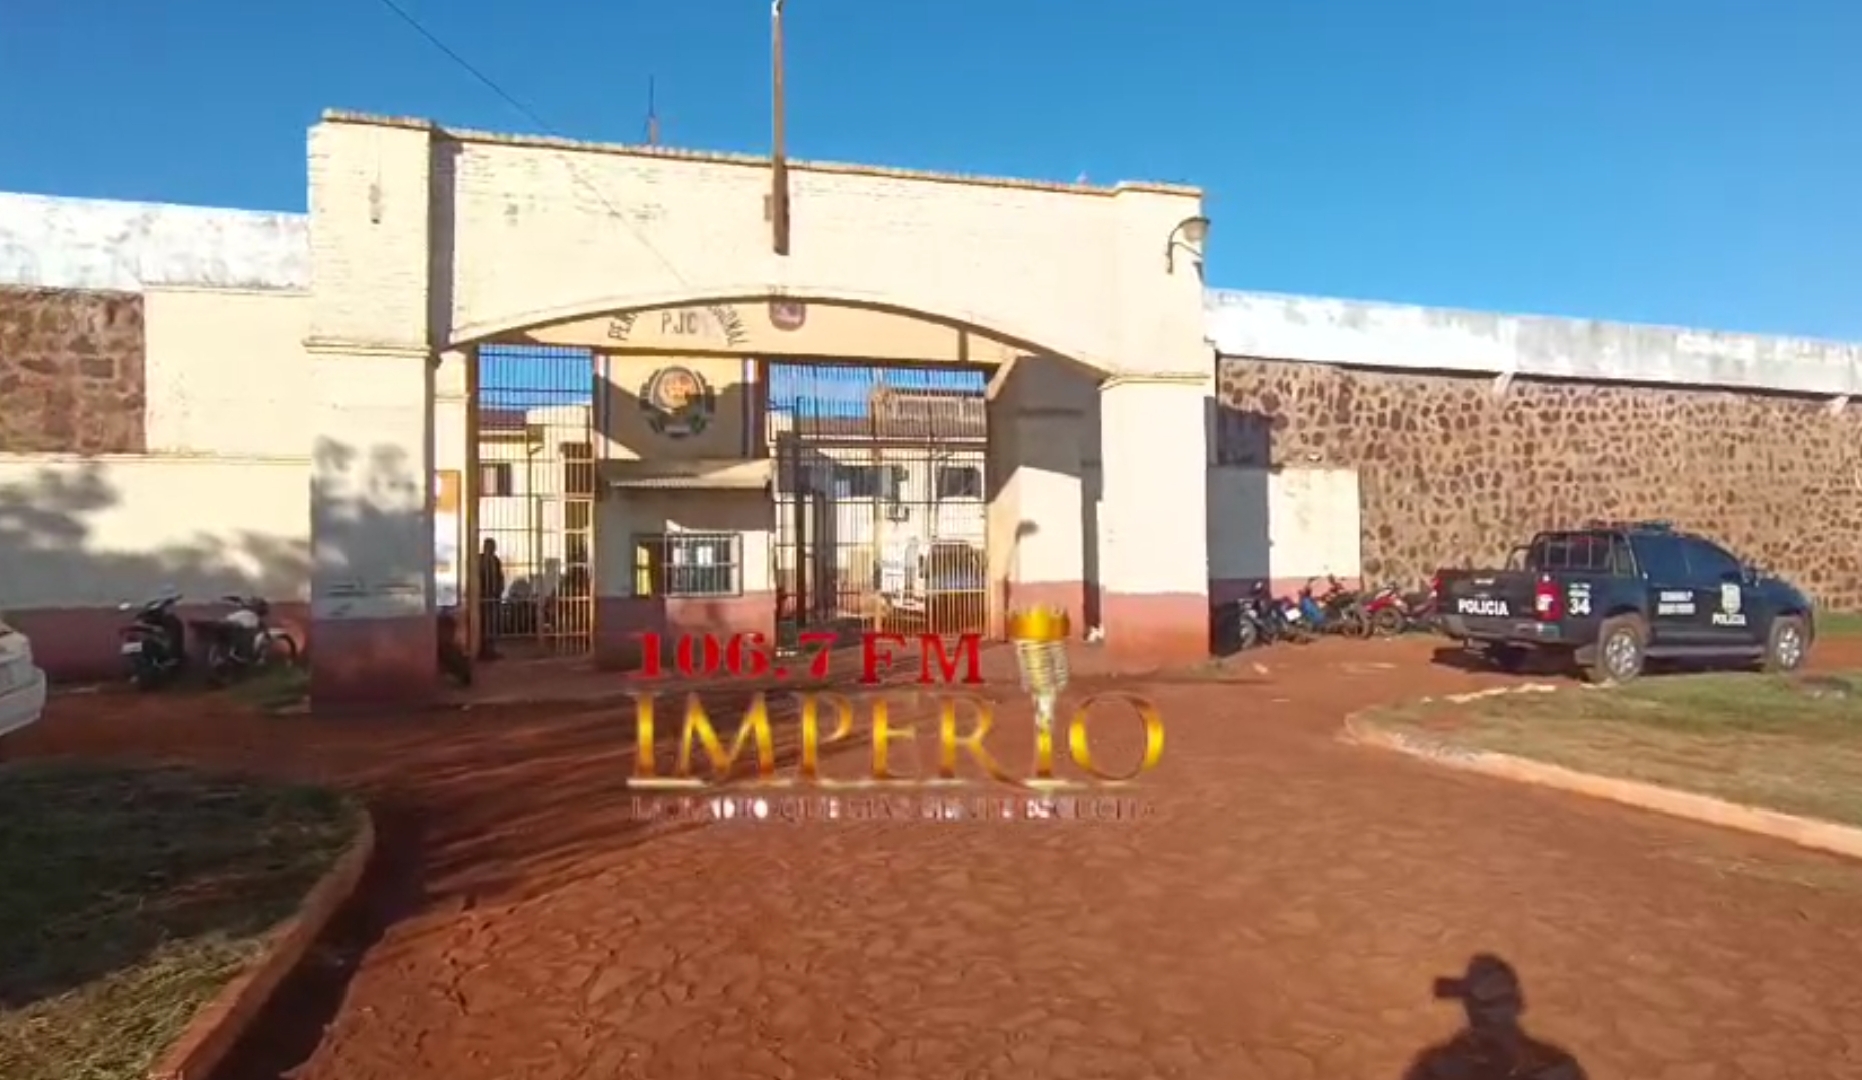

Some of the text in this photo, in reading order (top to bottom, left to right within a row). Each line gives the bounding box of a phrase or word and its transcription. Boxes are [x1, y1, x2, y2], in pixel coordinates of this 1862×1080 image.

[661, 310, 698, 334] PJC
[1458, 598, 1509, 615] POLICIA
[1569, 598, 1591, 615] 34
